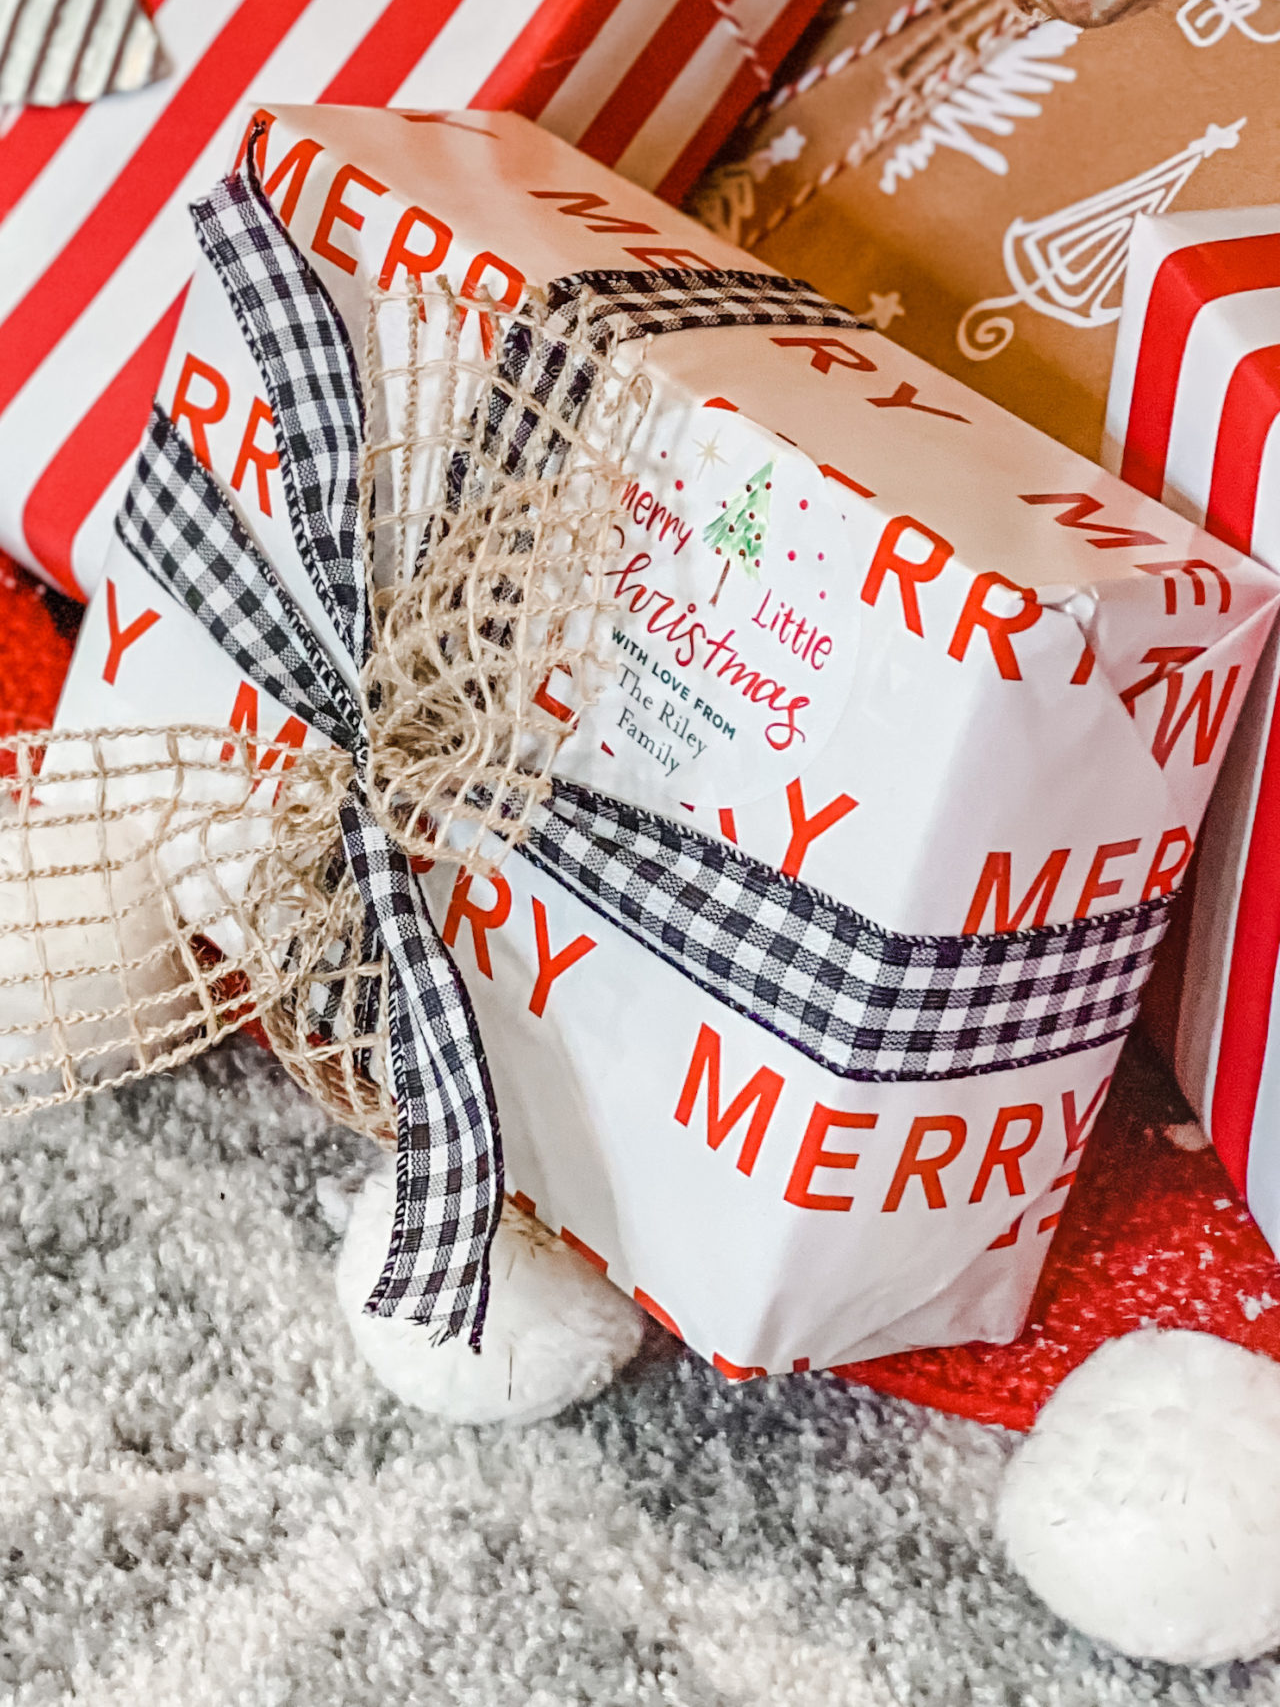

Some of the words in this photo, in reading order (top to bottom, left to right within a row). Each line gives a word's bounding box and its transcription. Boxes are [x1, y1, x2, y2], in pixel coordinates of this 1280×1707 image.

[752, 588, 832, 670] Little
[611, 626, 649, 667] WITH
[651, 660, 691, 702] LOVE
[693, 696, 737, 741] FROM
[619, 663, 655, 711] The
[658, 701, 709, 760] Riley
[616, 706, 681, 777] Family
